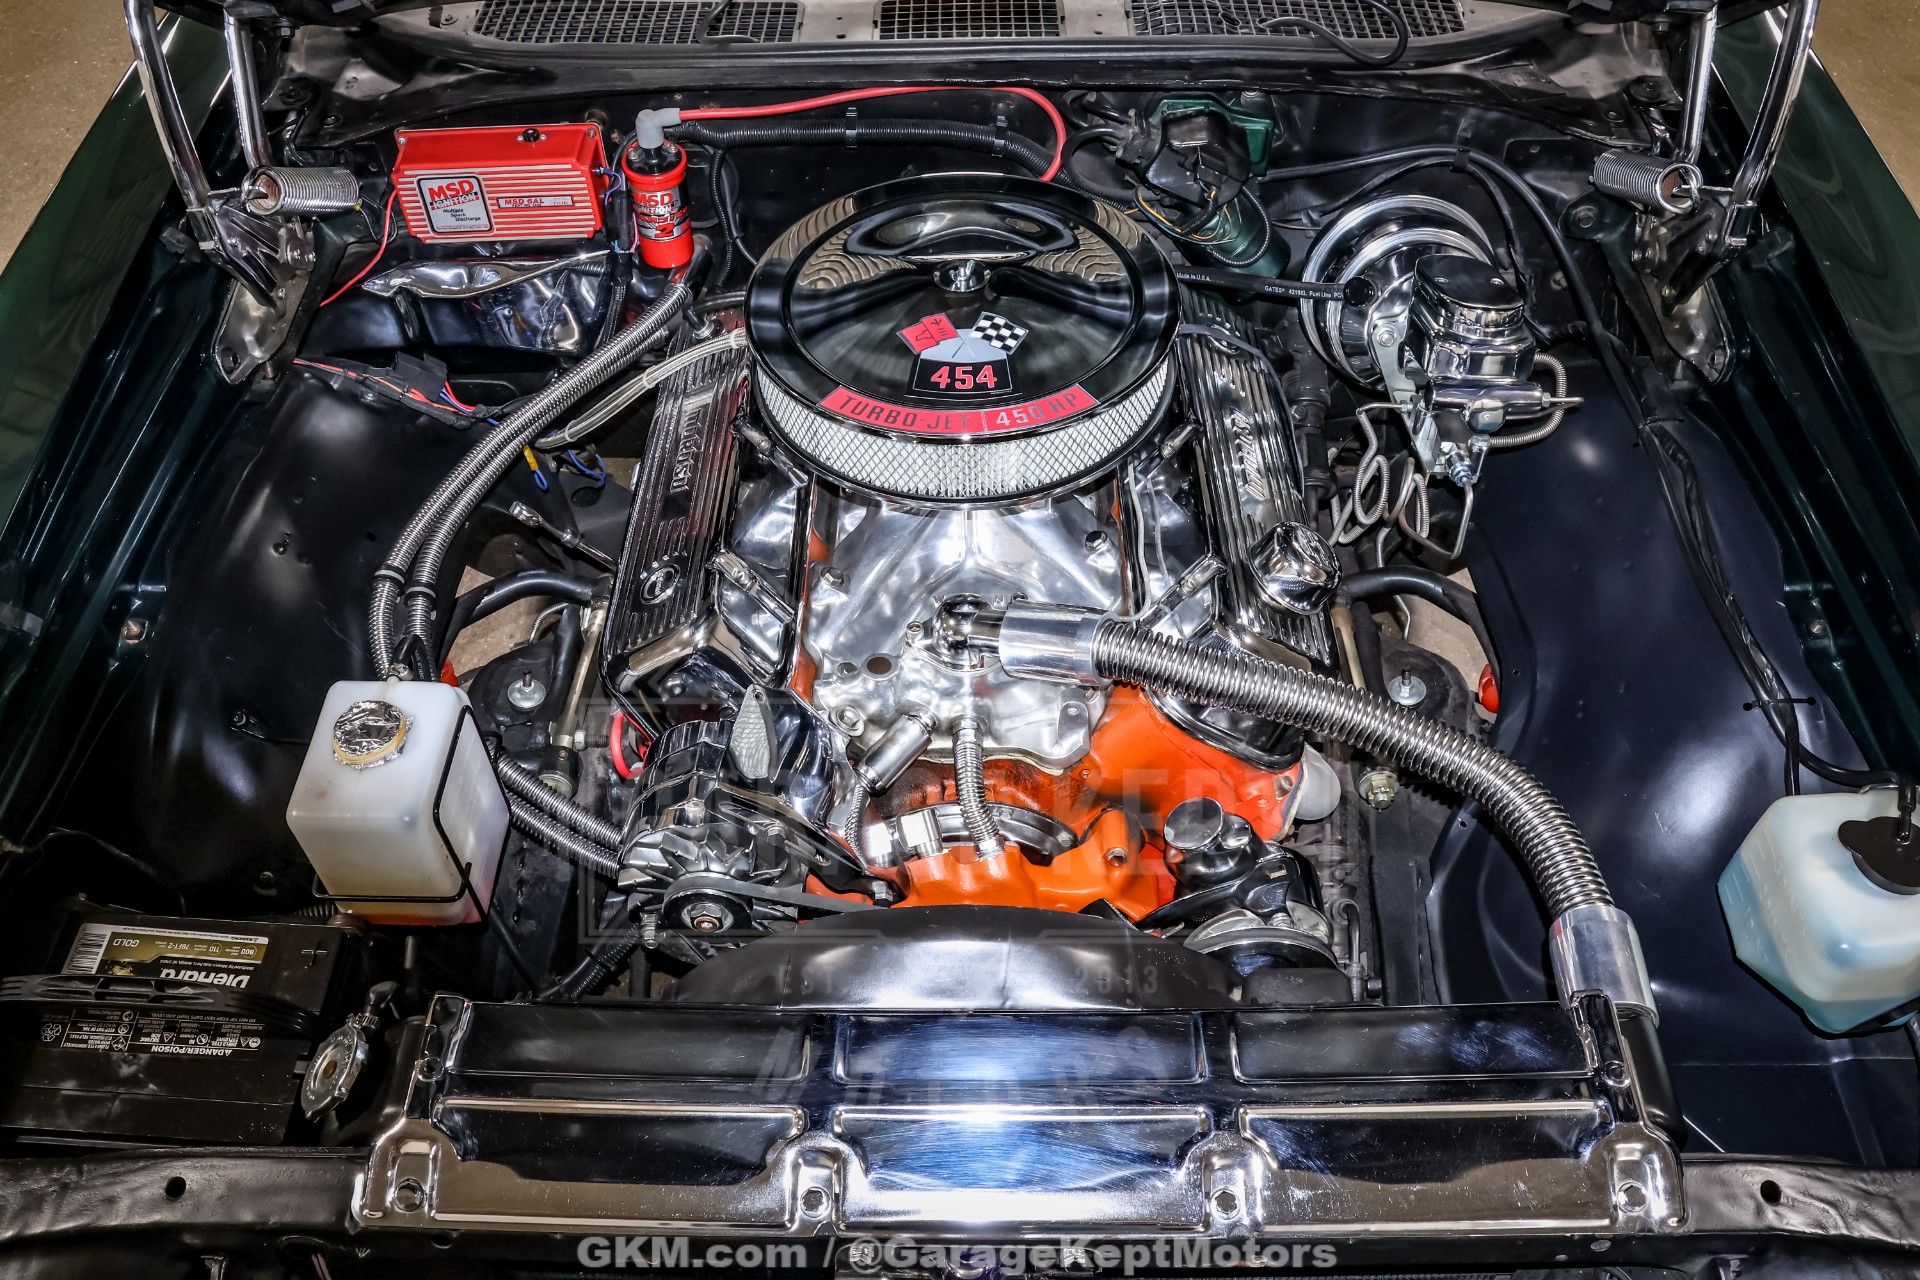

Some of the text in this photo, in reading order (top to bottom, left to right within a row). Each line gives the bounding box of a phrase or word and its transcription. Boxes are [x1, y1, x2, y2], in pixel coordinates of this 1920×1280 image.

[428, 179, 474, 201] MSD
[433, 193, 477, 208] IGNITION
[633, 192, 674, 207] MSD
[654, 223, 675, 238] 2
[930, 364, 998, 390] 454
[838, 392, 1078, 431] TURBO-JET 450 HP
[113, 938, 140, 948] GOLD
[152, 1045, 224, 1056] DANGER/POISON
